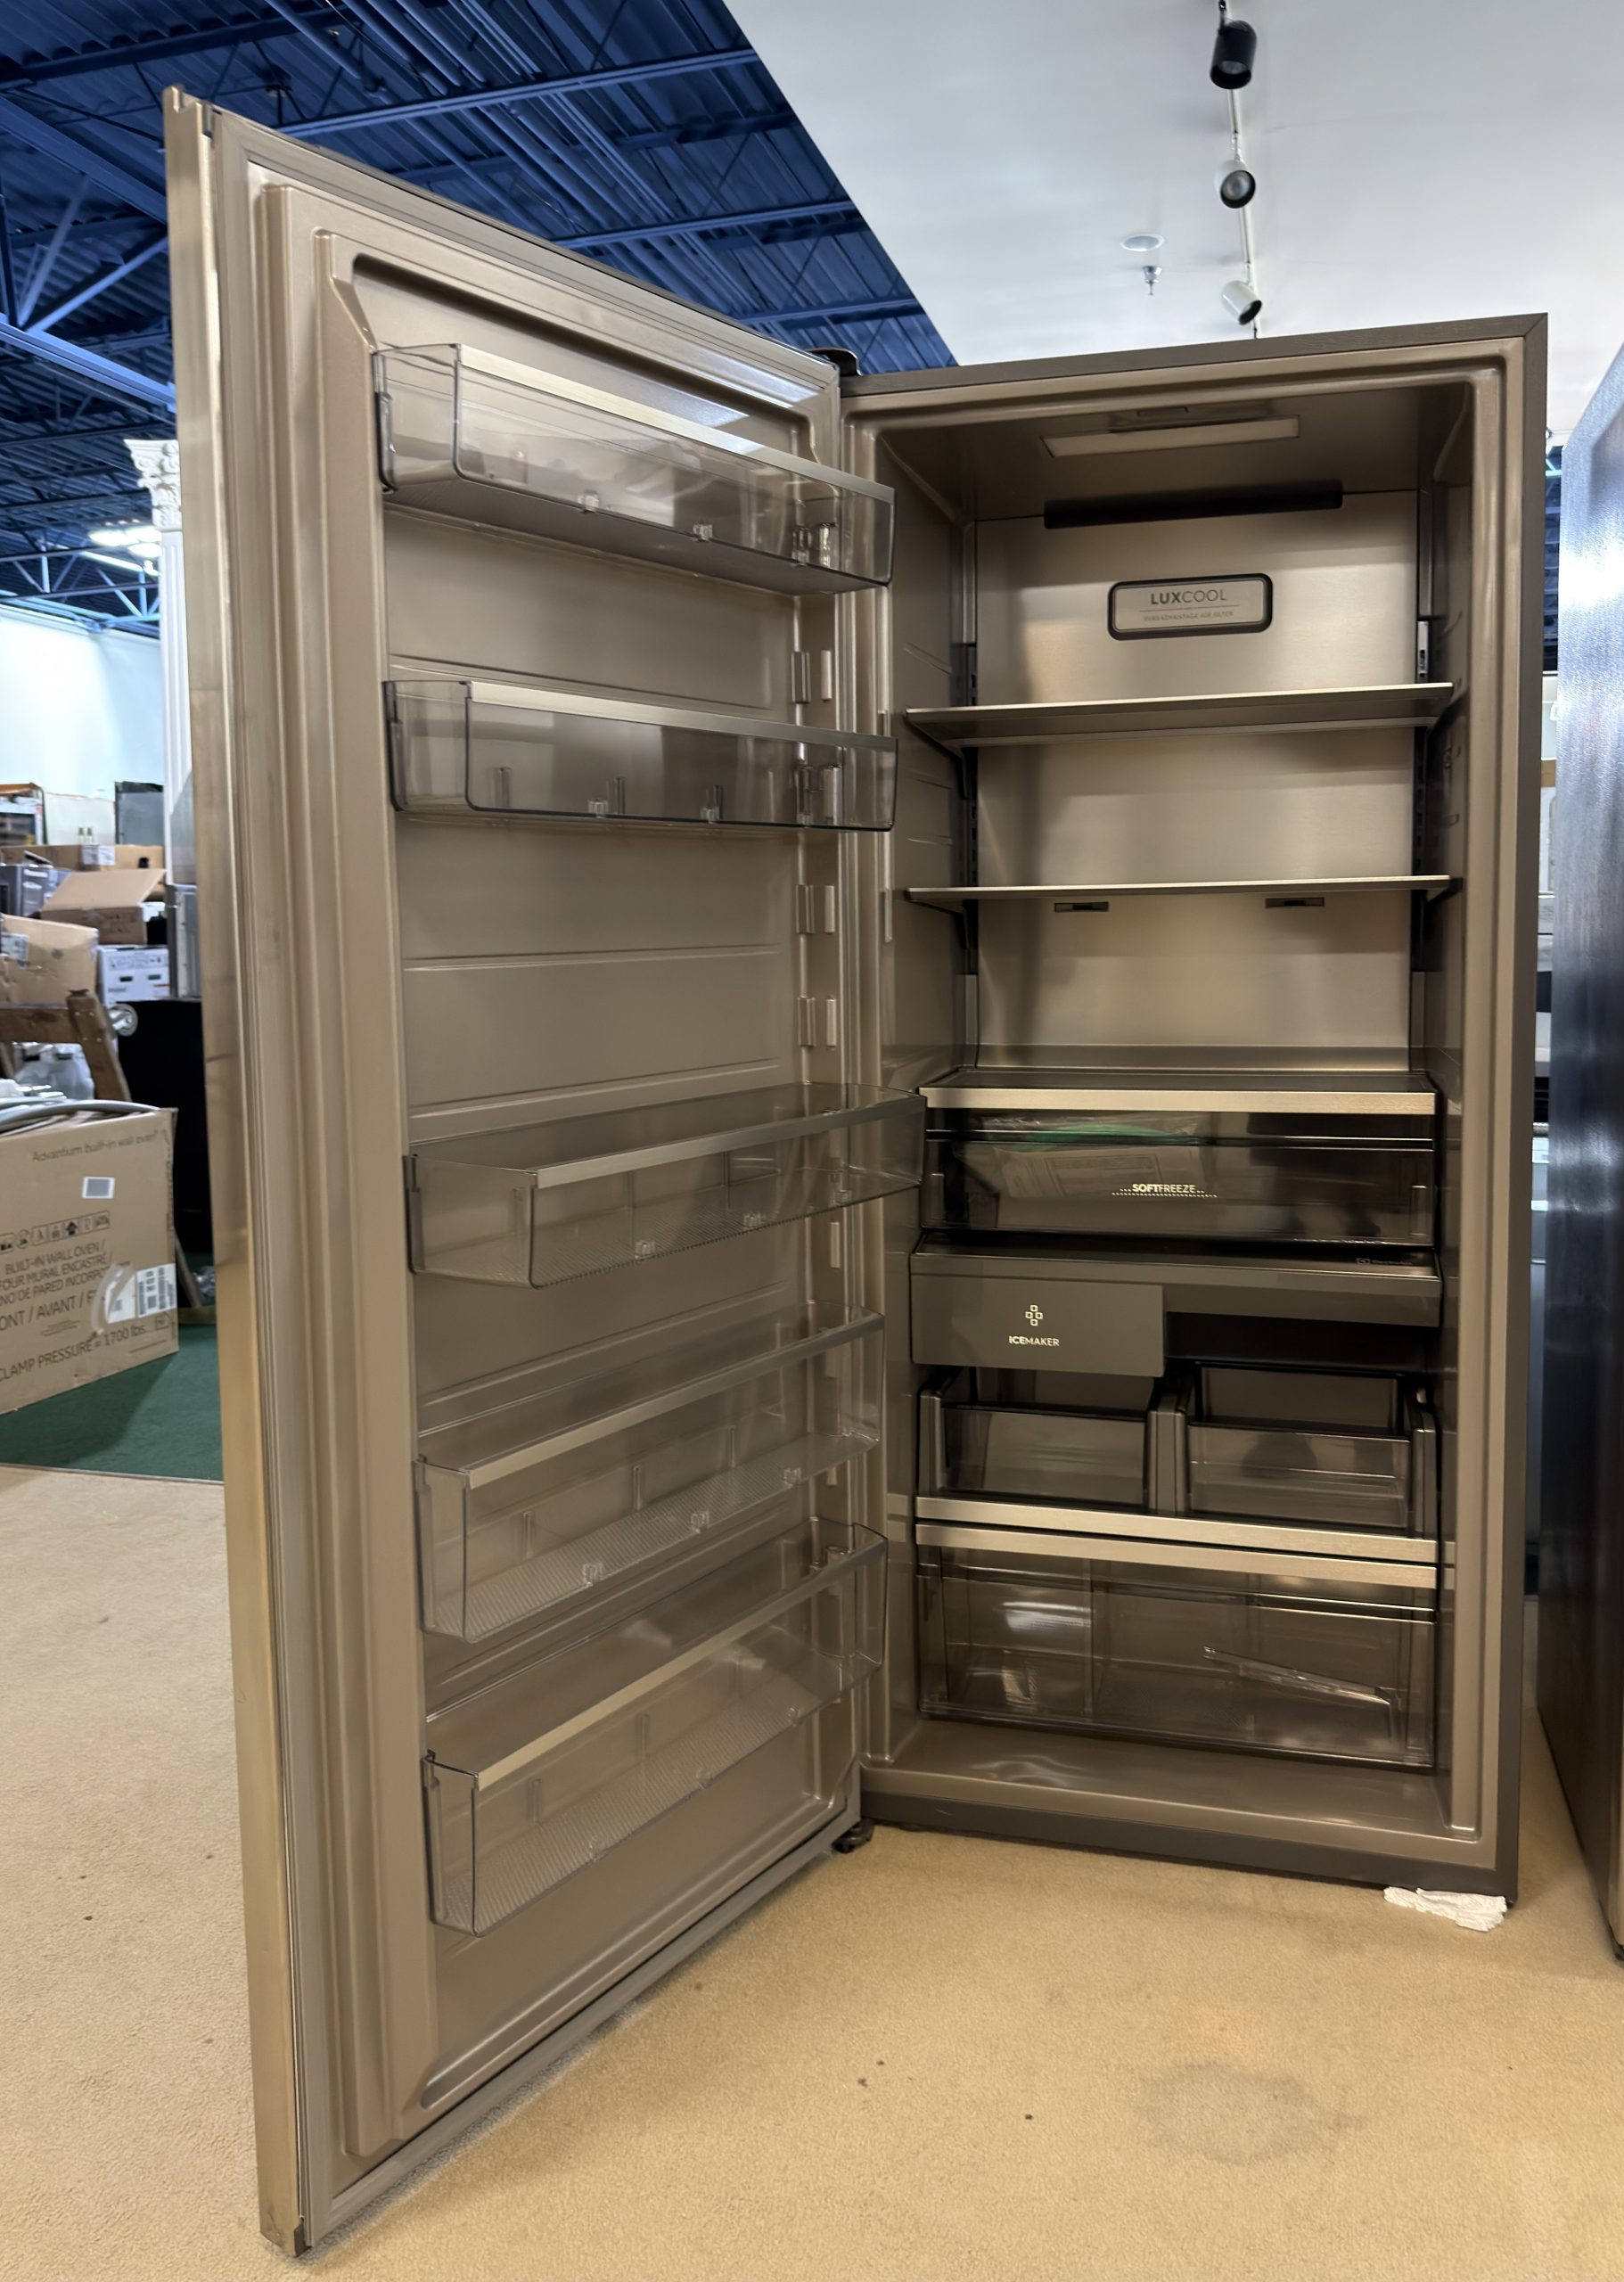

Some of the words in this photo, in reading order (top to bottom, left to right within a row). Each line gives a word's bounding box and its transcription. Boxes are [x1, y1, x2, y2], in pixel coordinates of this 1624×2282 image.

[1151, 588, 1227, 605] LUXCOOL
[1132, 1183, 1196, 1194] SOFTFREEZE
[5, 1256, 45, 1275] BUILT-IN
[46, 1250, 73, 1265] WALL
[74, 1243, 100, 1258] OVEN
[37, 1294, 77, 1320] AVANT
[38, 1339, 94, 1369] PRESSURE
[104, 1327, 129, 1346] 1700
[1008, 1335, 1060, 1347] ICEMAKER
